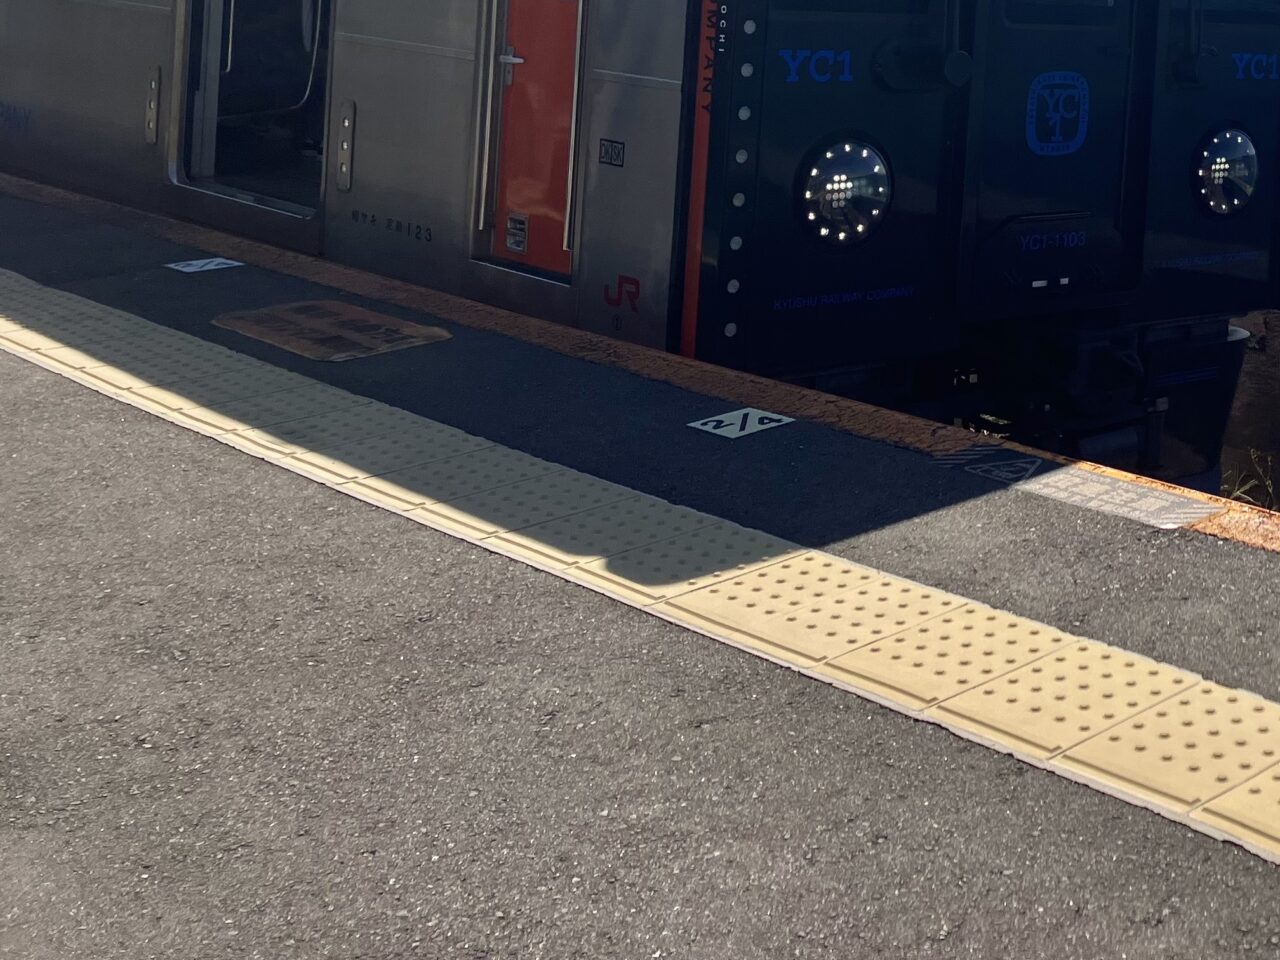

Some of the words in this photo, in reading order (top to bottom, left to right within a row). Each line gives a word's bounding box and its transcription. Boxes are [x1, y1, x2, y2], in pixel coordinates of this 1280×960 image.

[779, 48, 854, 82] YC1
[1232, 52, 1280, 80] YC1
[1019, 230, 1088, 251] YC1-1103
[604, 275, 640, 312] JR
